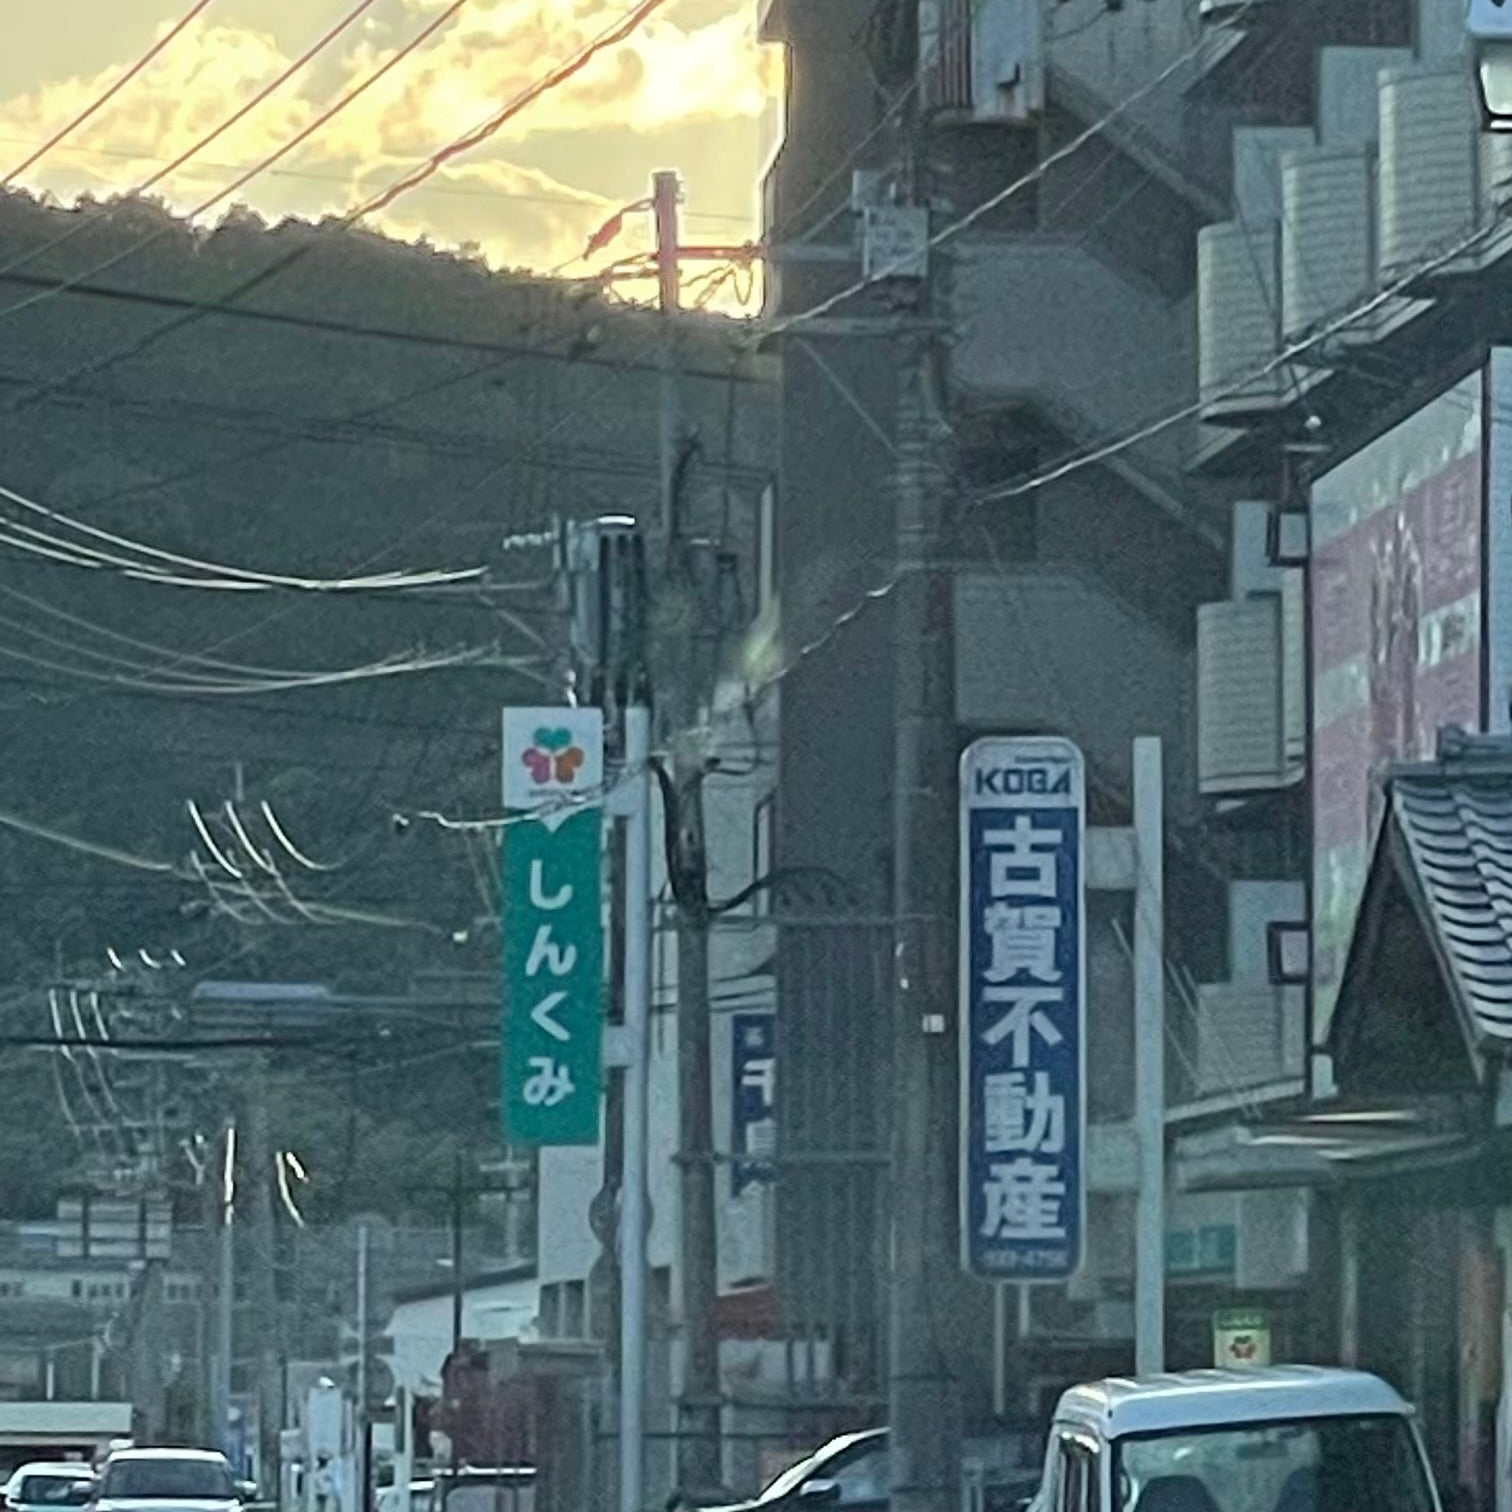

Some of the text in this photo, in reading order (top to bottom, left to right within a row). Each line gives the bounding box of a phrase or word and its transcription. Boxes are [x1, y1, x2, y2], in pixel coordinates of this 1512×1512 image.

[523, 859, 577, 1106] しんくみ
[981, 816, 1066, 1239] 古賀不動産
